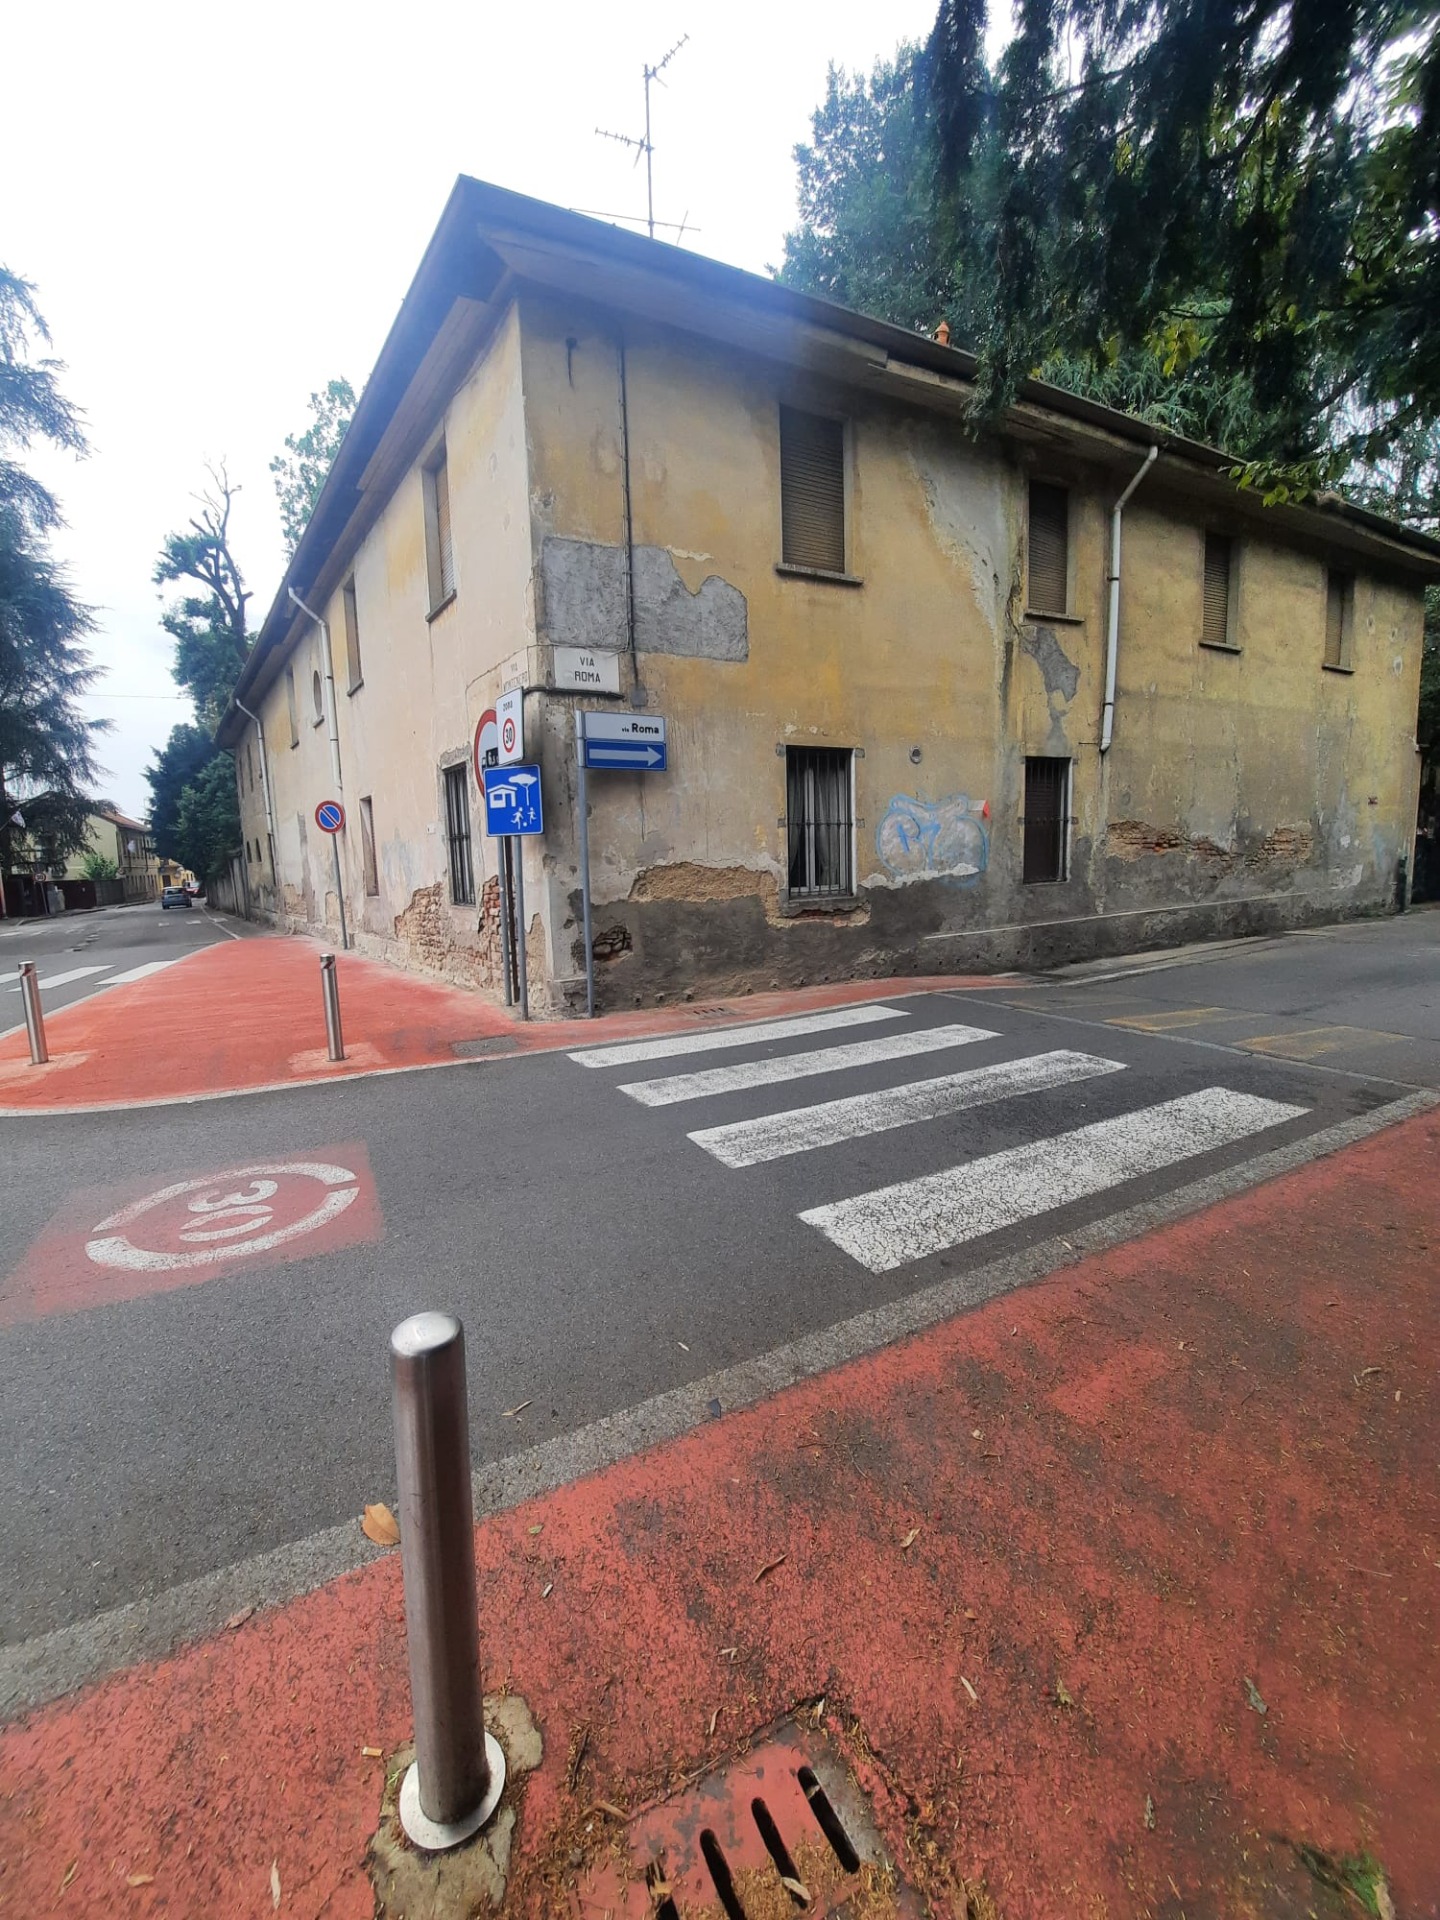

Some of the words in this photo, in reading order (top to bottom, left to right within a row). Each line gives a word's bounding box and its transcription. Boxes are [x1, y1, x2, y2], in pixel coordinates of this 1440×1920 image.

[579, 655, 595, 667] VIA
[574, 670, 601, 684] ROMA
[631, 722, 660, 735] Roma
[505, 726, 513, 745] 30
